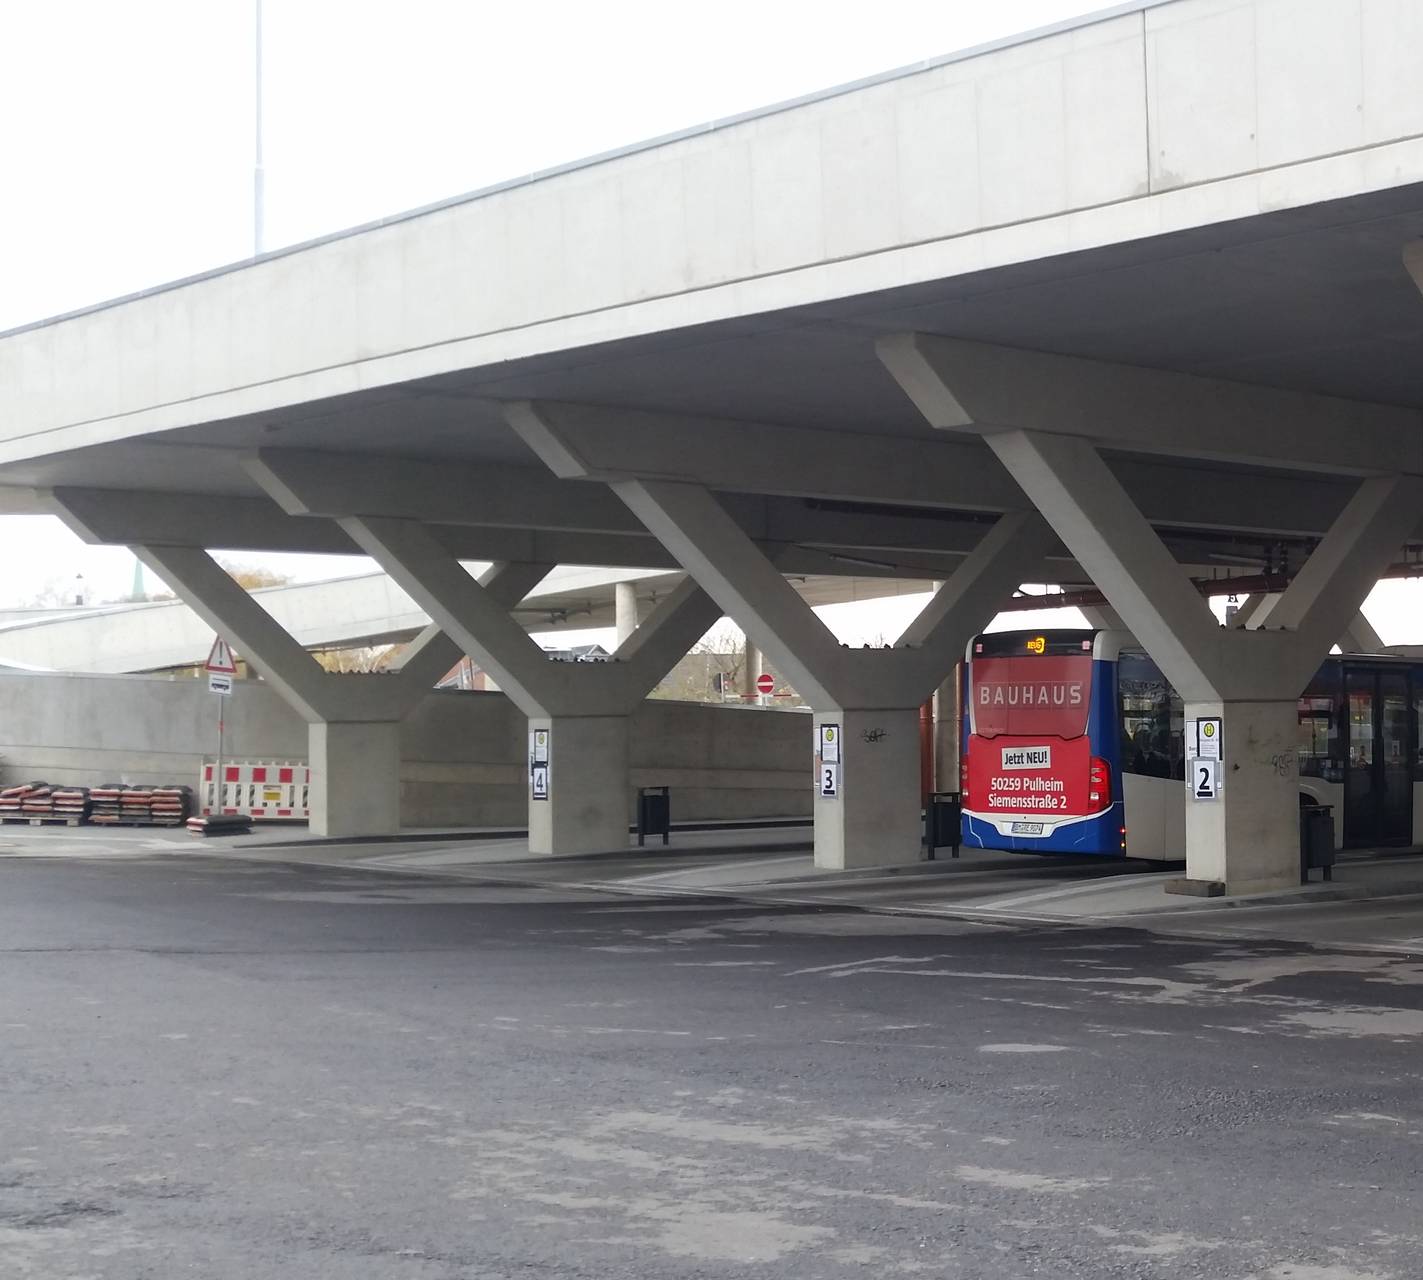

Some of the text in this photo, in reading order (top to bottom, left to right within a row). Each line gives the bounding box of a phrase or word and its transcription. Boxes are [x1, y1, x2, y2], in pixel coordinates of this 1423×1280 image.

[980, 685, 1082, 705] BAUHAUS
[1004, 750, 1048, 765] Jetzt NEU!
[536, 773, 544, 791] 4
[825, 769, 833, 789] 3
[991, 777, 1064, 792] 50259 Pulheim
[1199, 767, 1210, 790] 2
[988, 794, 1067, 809] Siemensstraße 2
